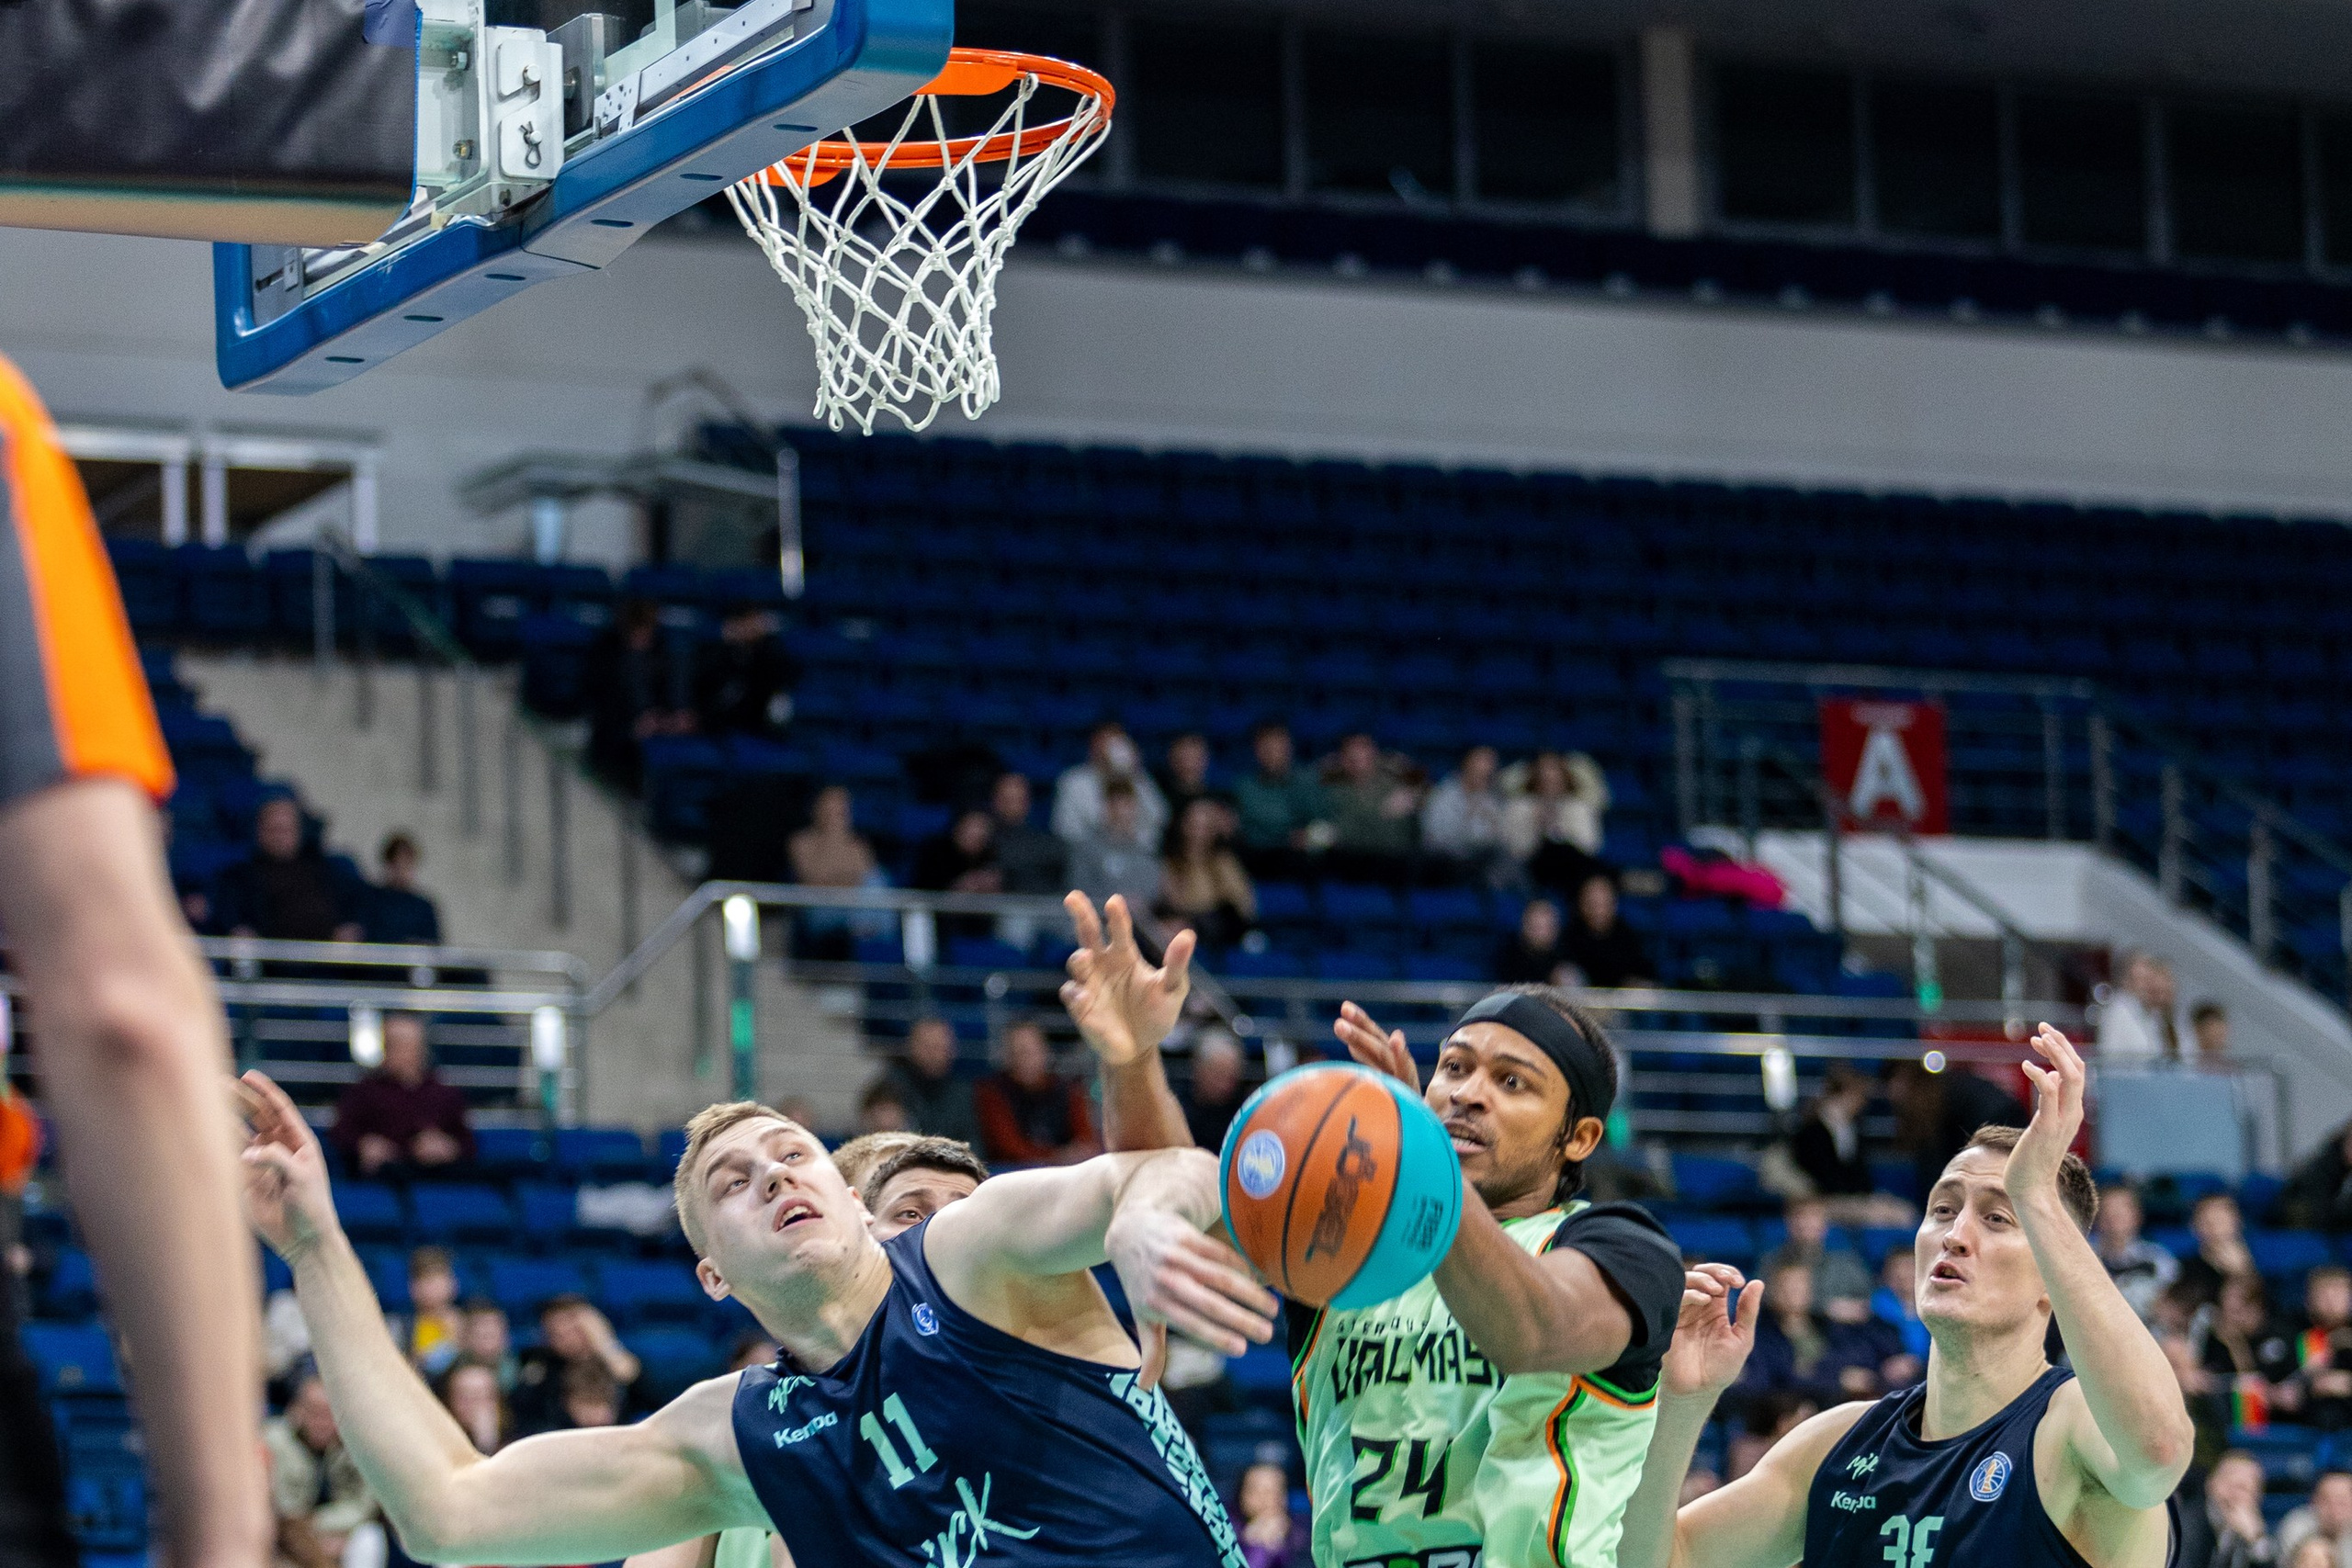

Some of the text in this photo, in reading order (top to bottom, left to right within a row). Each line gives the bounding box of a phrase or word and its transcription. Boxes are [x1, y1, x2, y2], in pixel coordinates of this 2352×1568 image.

[1849, 726, 1926, 819] A
[860, 1392, 938, 1490] 11
[1351, 1437, 1452, 1521] 24
